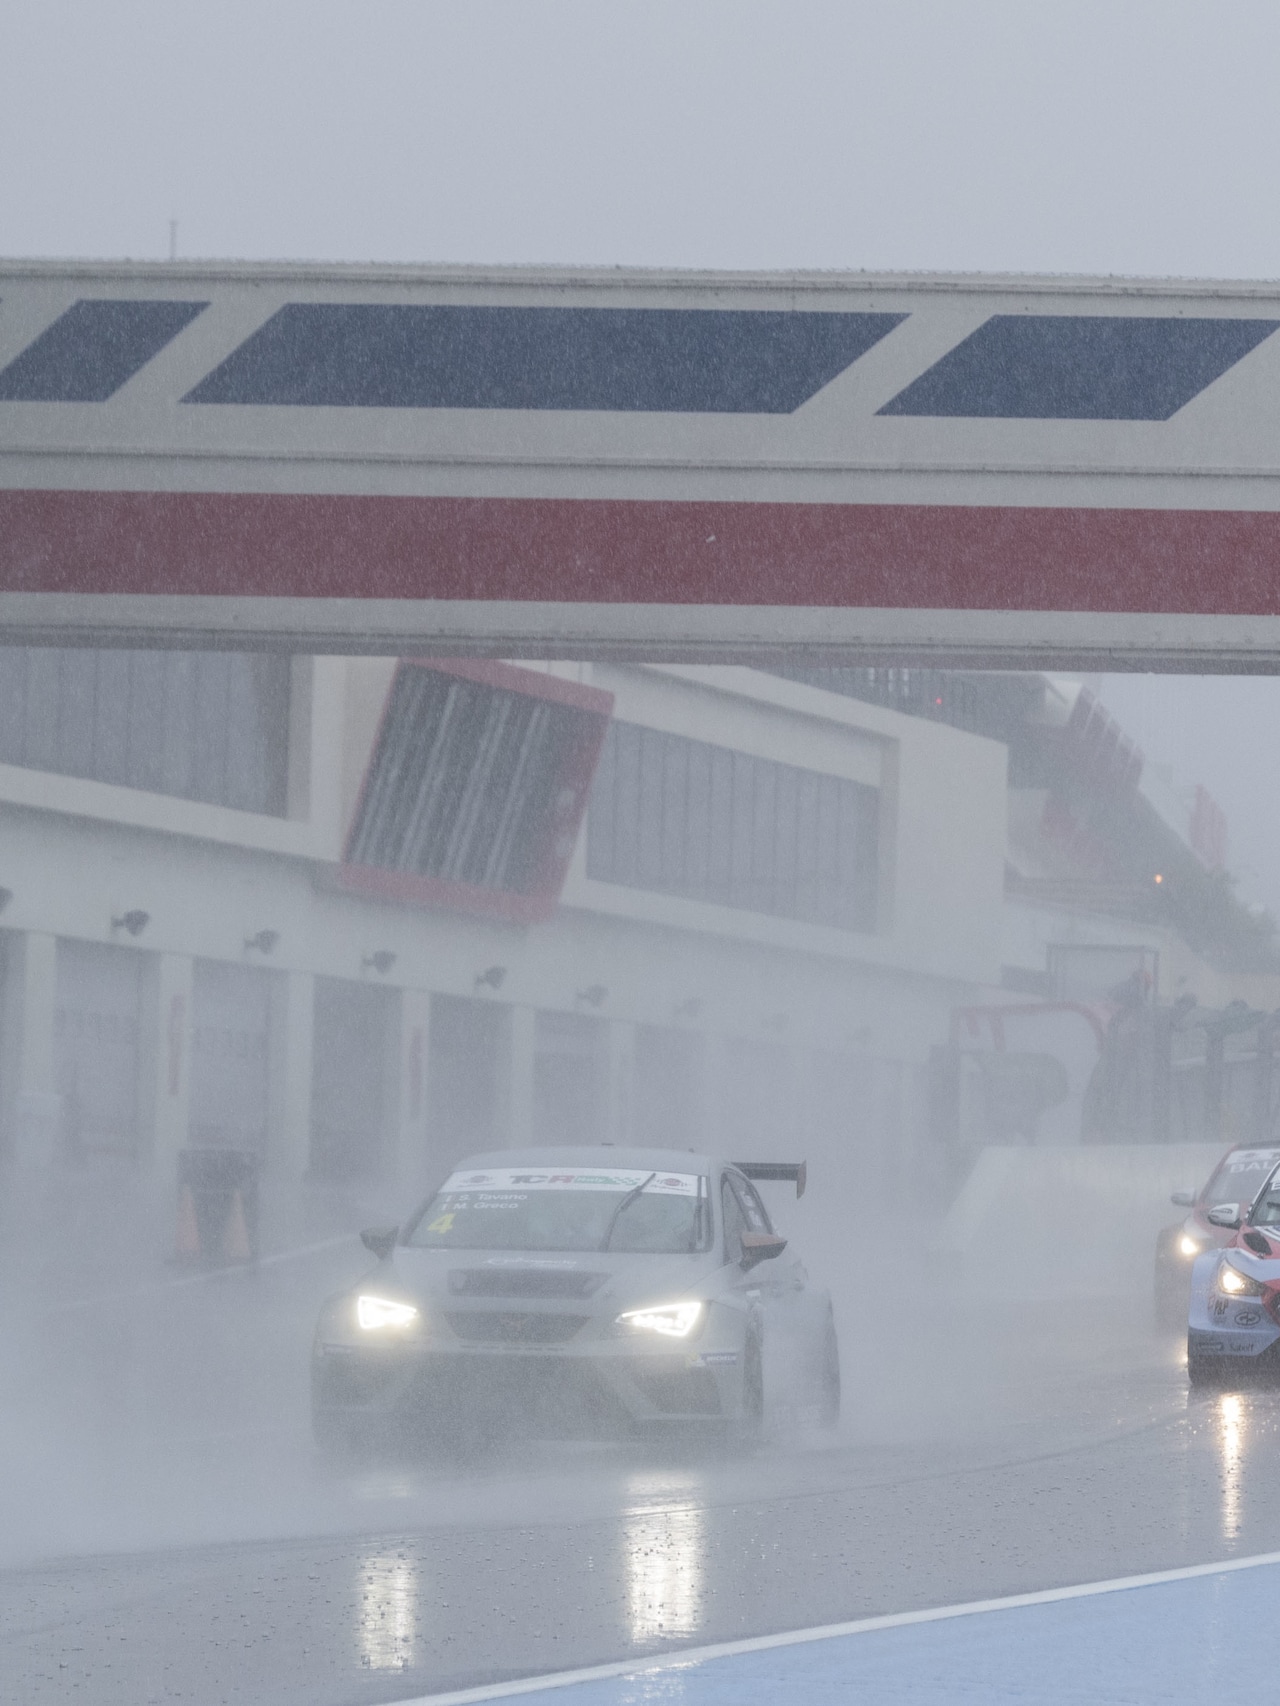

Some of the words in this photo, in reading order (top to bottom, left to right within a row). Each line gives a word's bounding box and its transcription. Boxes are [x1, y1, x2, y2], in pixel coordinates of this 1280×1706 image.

[477, 1193, 528, 1201] Tavano
[473, 1201, 519, 1209] Greco
[427, 1213, 456, 1234] 4
